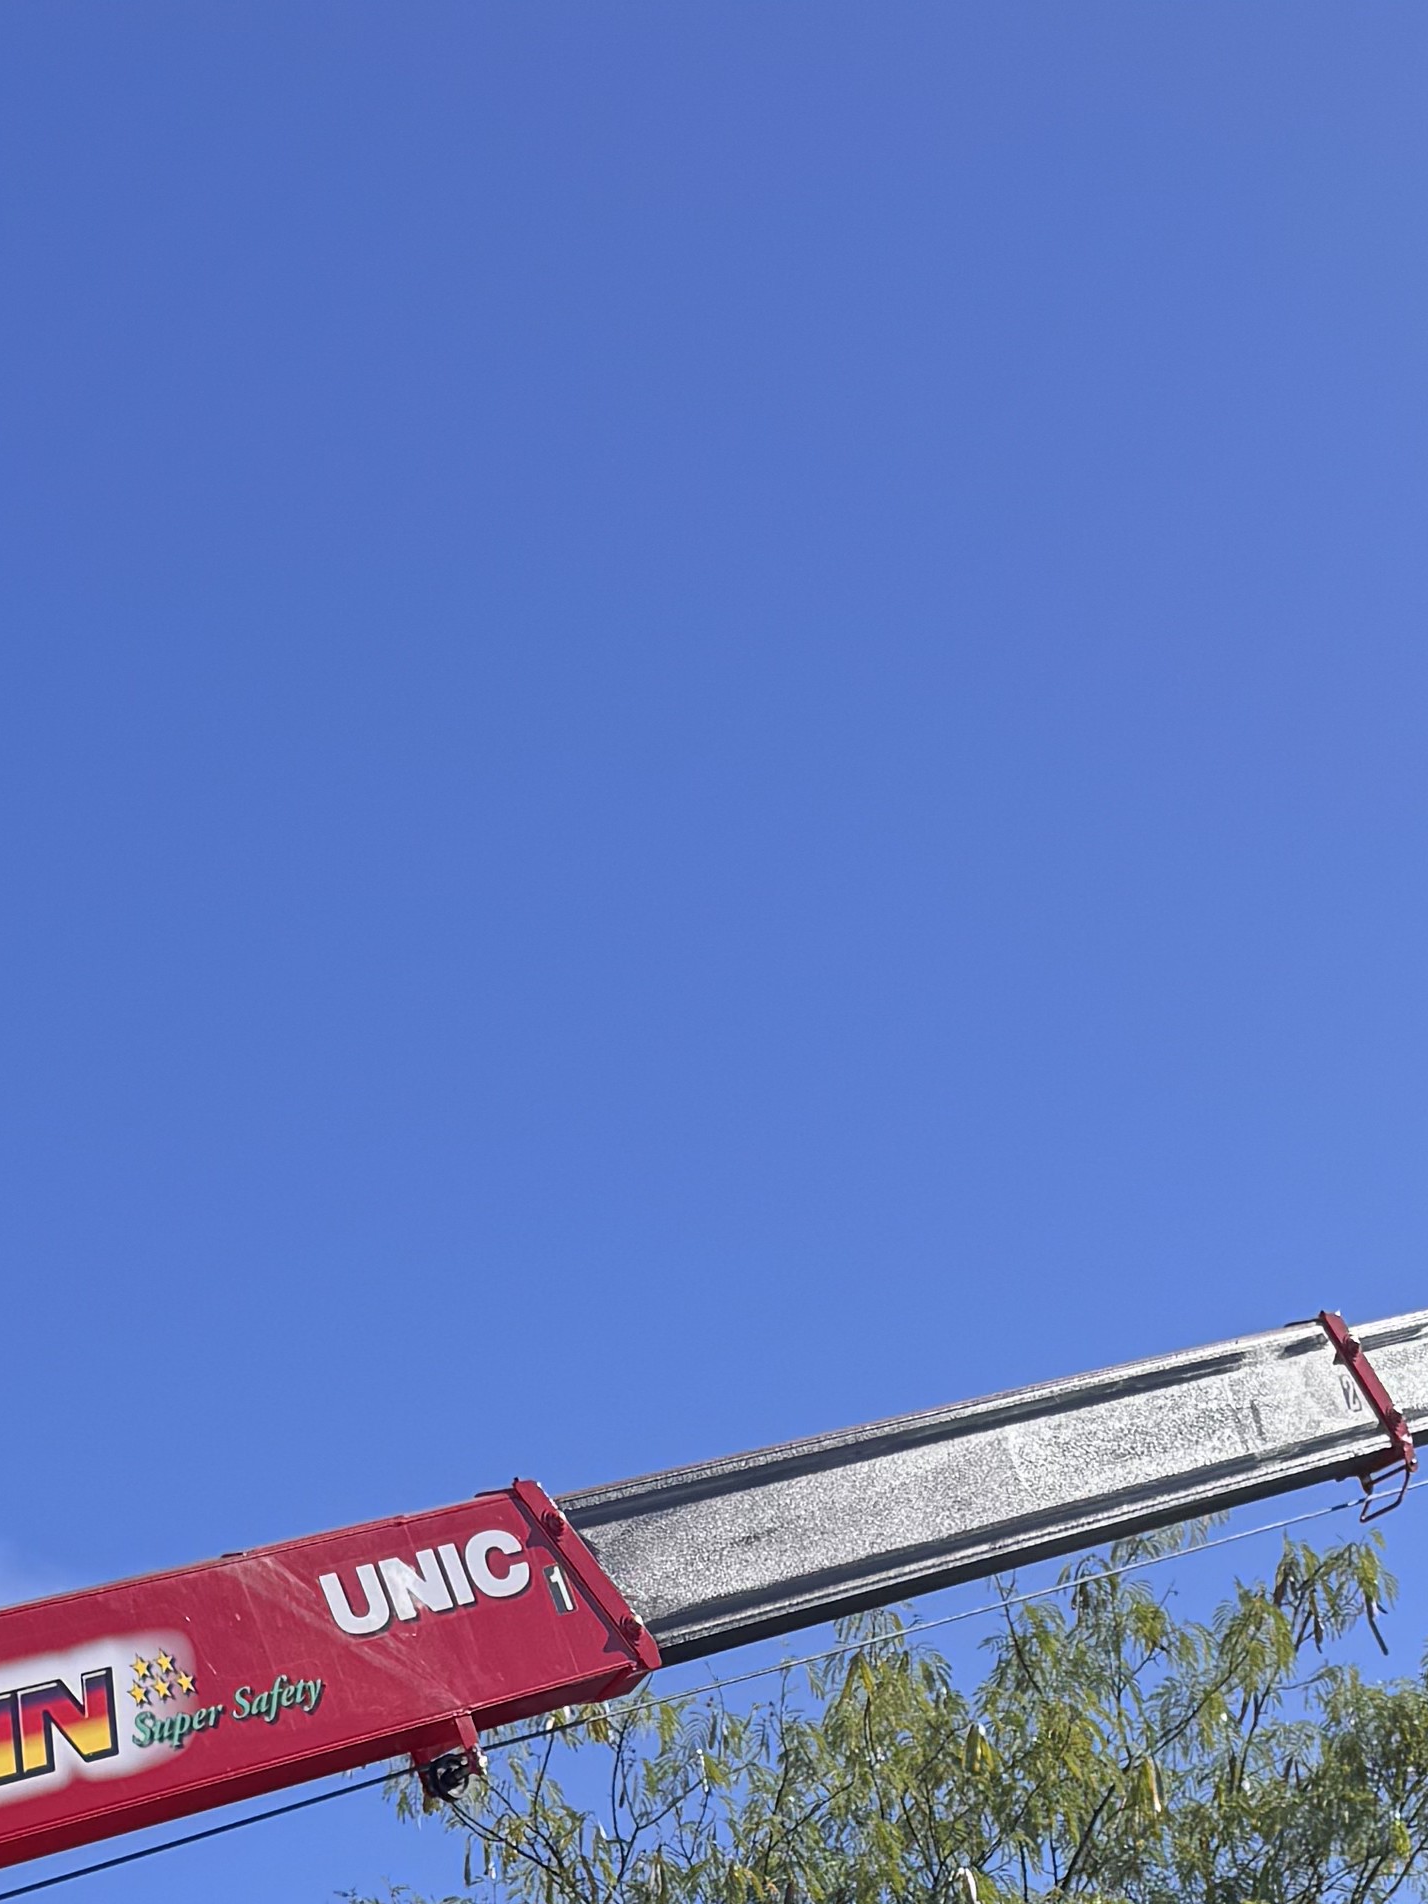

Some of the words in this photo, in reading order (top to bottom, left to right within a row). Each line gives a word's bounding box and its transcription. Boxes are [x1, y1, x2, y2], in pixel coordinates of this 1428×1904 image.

[1342, 1375, 1361, 1411] 2
[318, 1529, 530, 1635] UNIC
[549, 1566, 573, 1611] 1
[132, 1703, 225, 1749] Super
[232, 1674, 326, 1724] Safety
